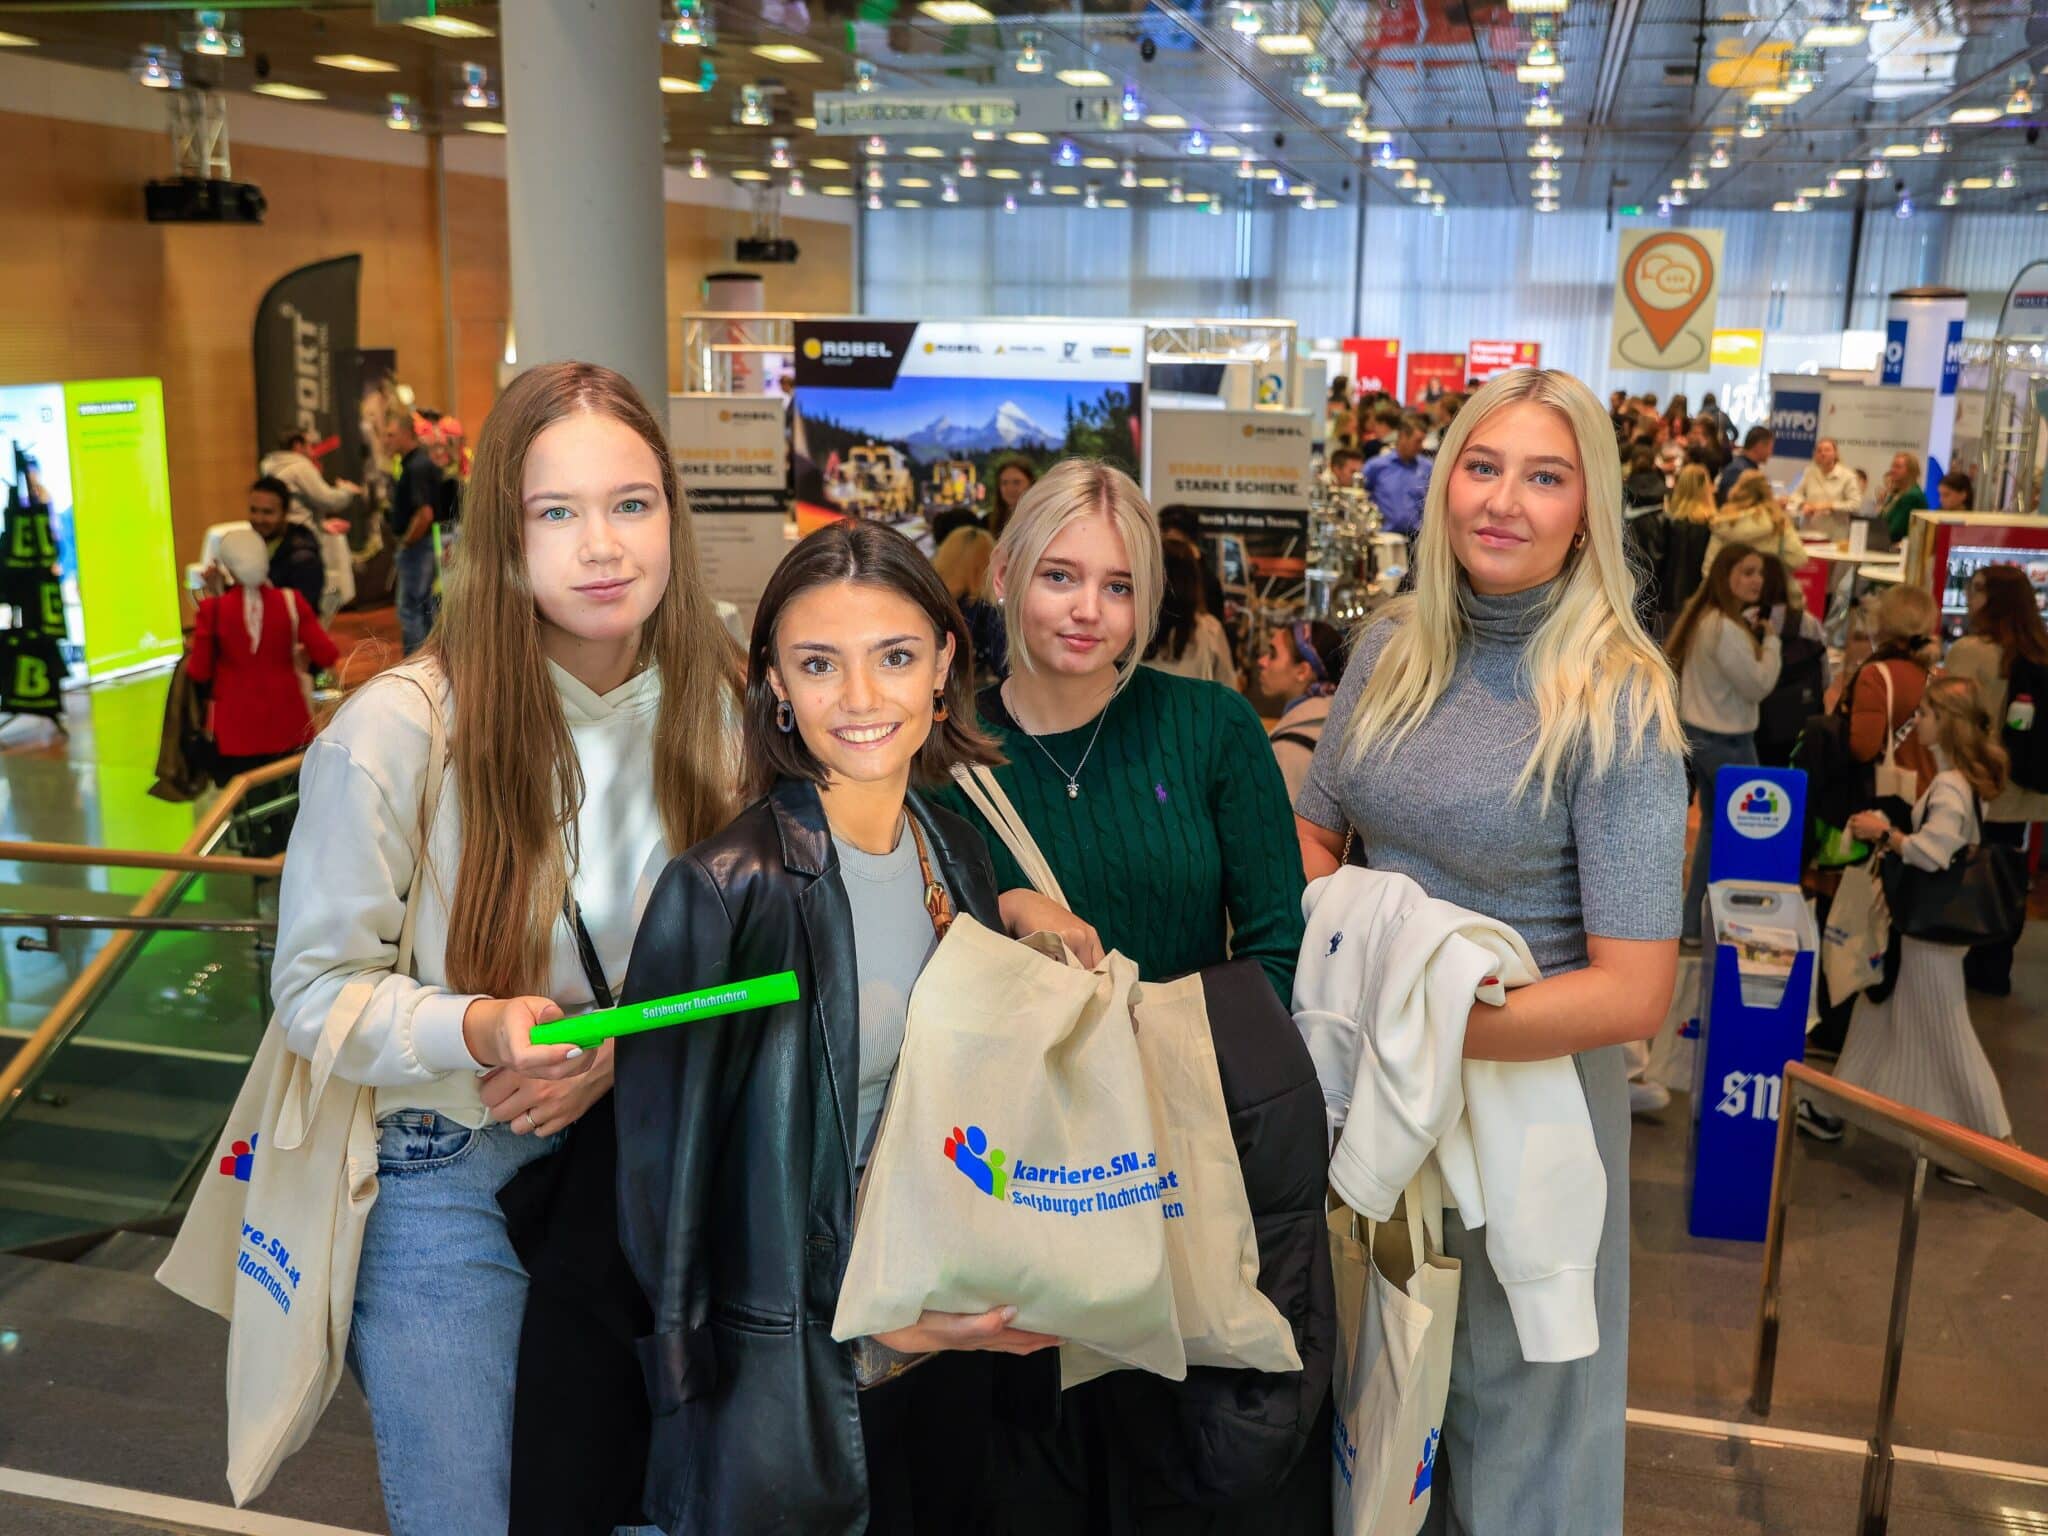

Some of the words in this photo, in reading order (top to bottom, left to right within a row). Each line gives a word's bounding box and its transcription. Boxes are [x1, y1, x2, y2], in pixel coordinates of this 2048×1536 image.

[822, 341, 893, 358] ROBEL
[1771, 410, 1817, 431] HYPO
[1175, 479, 1230, 493] STARKE
[1235, 481, 1301, 496] SCHIENE.
[15, 654, 51, 698] B
[642, 1000, 693, 1020] Salzburger
[693, 989, 748, 1009] Nachrichten
[1012, 1151, 1157, 1185] karriere.SN.a
[1012, 1190, 1094, 1217] Salzburger
[1095, 1182, 1160, 1212] Nachrich
[242, 1219, 301, 1288] re.SN.at
[237, 1252, 292, 1315] Nachrichten
